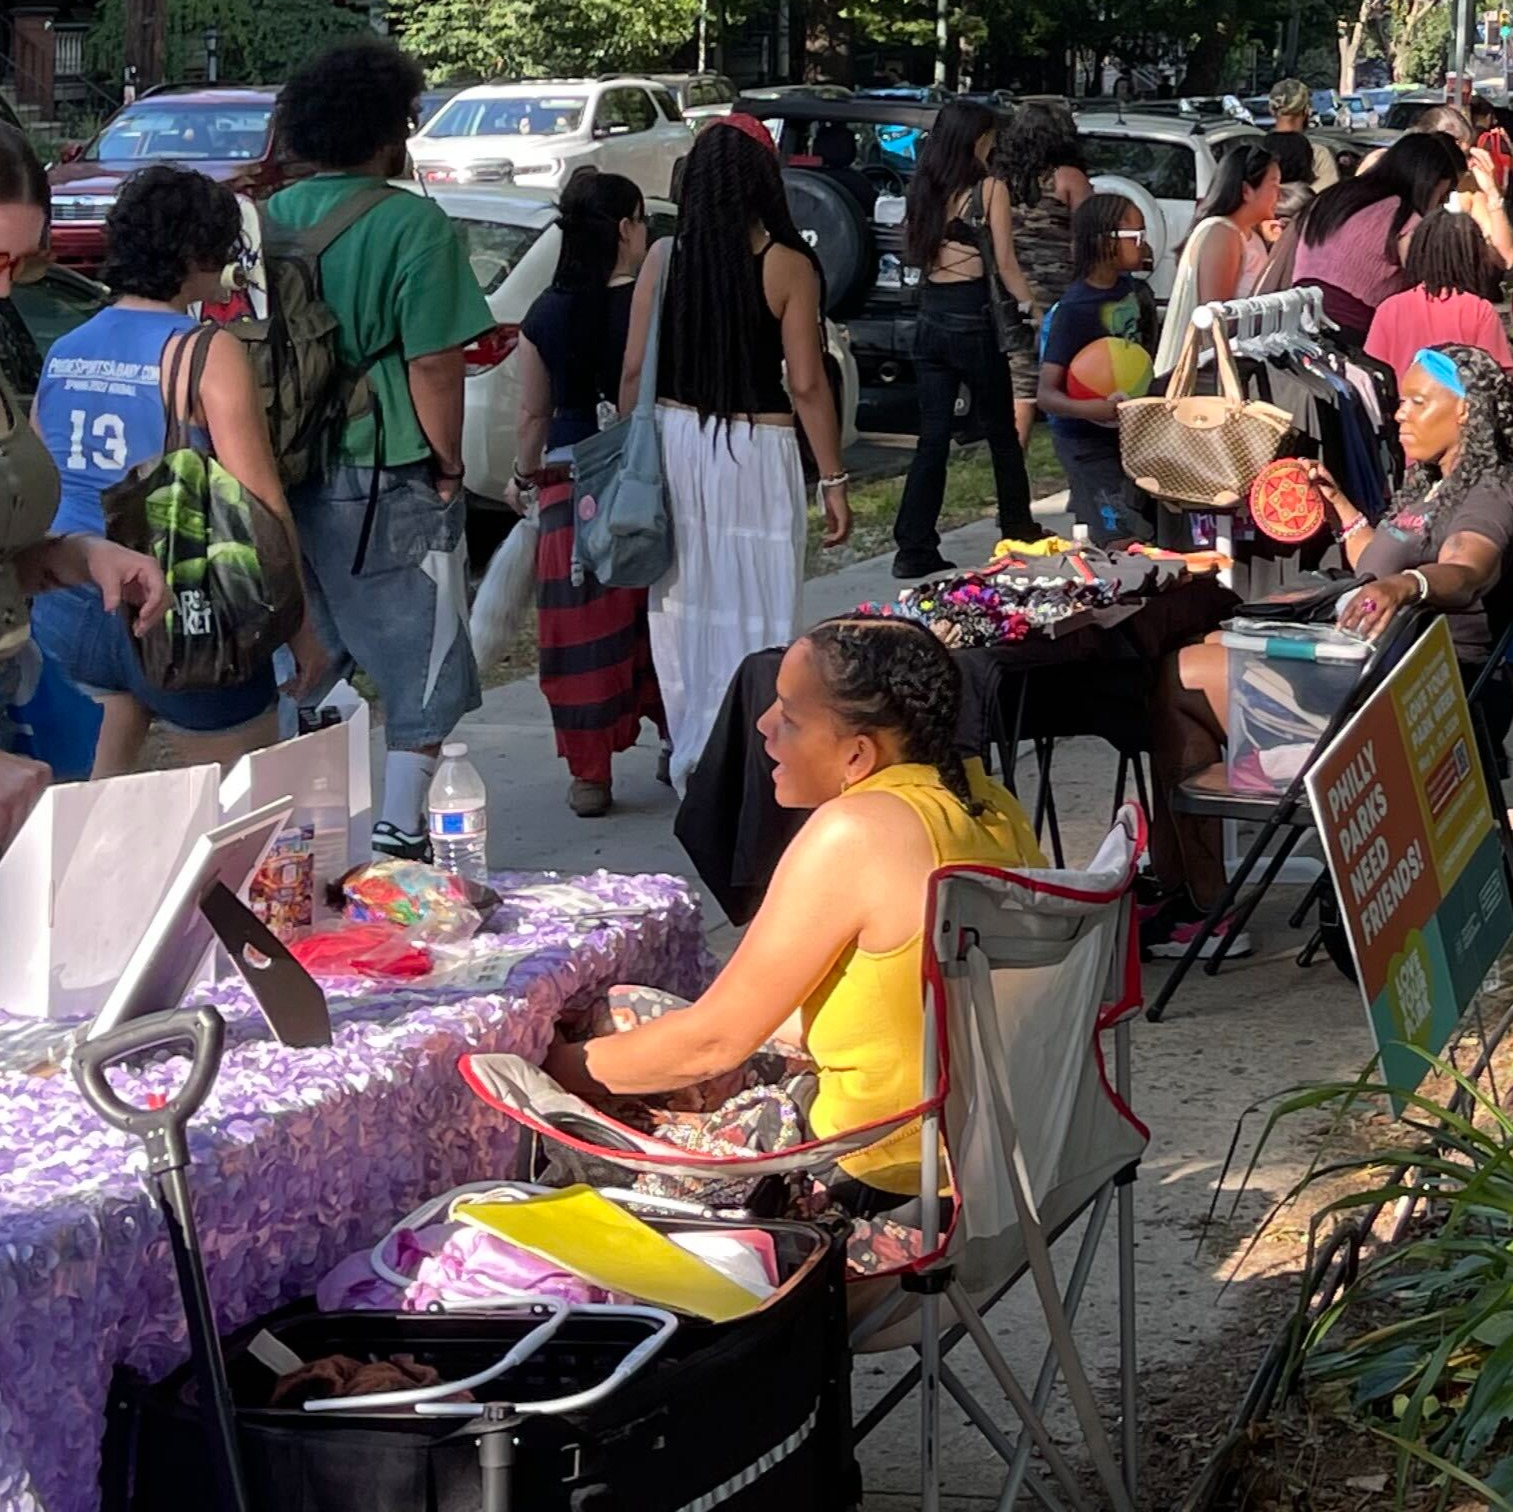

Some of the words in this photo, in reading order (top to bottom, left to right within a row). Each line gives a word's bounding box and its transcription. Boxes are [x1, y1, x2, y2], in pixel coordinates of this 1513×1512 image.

[67, 410, 127, 470] 13
[1327, 738, 1378, 824] PHILLY
[1338, 782, 1388, 865] PARKS
[1349, 834, 1390, 905] NEED
[1359, 838, 1424, 947] FRIENDS!
